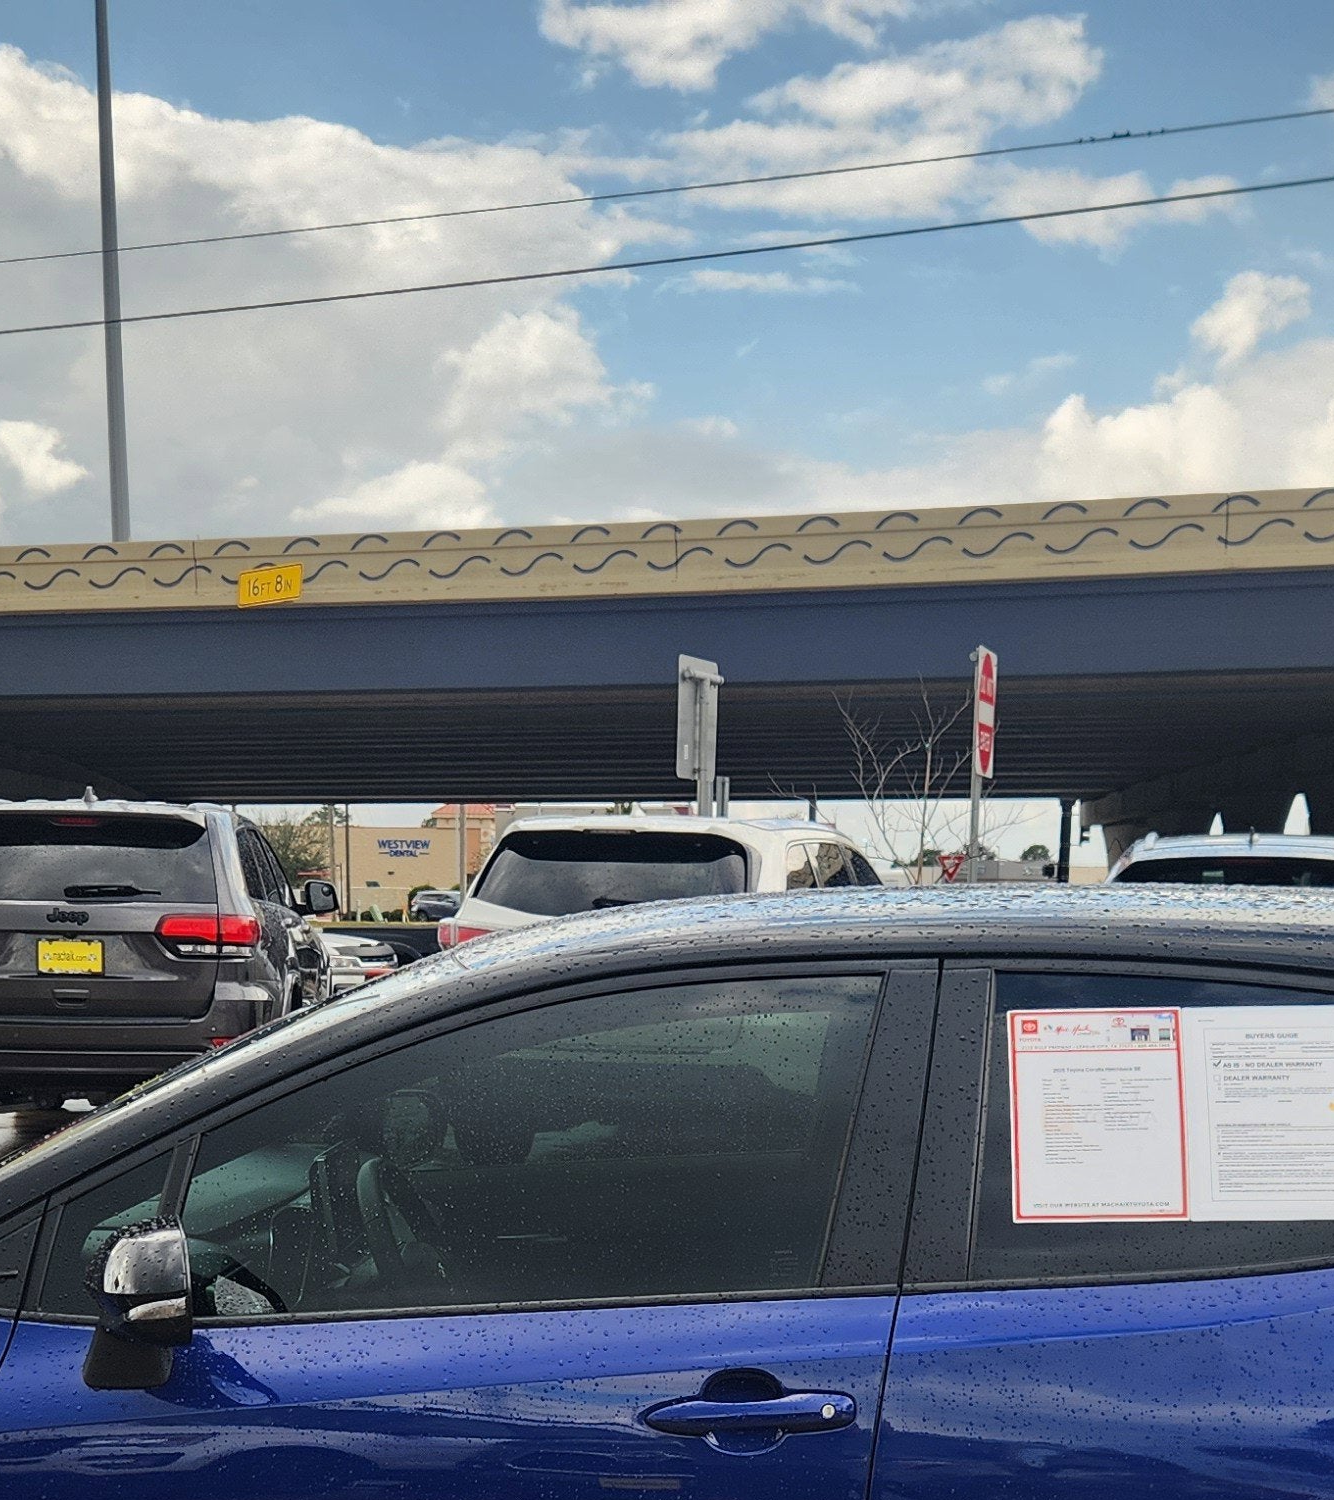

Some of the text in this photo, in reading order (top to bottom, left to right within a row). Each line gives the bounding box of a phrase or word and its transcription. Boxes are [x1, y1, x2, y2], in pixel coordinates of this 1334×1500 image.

[377, 839, 431, 849] WESTVIEW
[389, 849, 418, 857] DENTAL
[46, 907, 90, 926] Jeep
